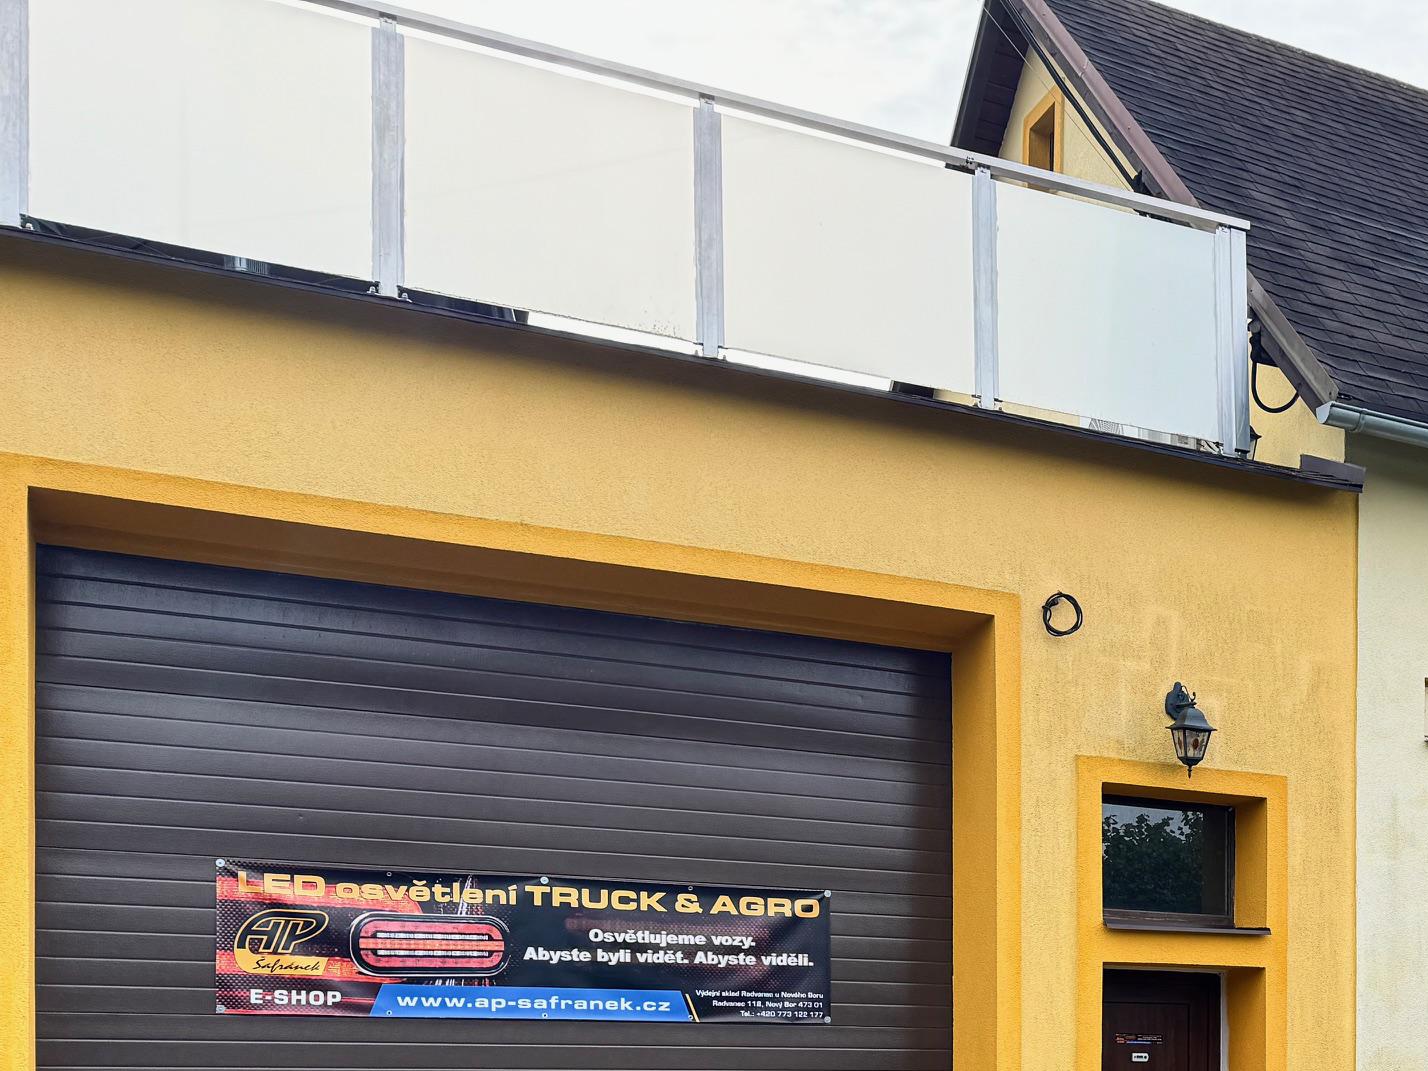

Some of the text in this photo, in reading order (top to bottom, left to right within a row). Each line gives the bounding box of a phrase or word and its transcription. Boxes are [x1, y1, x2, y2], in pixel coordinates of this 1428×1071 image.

[238, 870, 820, 918] LED osvětlení TRUCK & AGRO
[588, 928, 756, 949] Osvětlujeme vozy.
[252, 956, 321, 973] Šafránek
[523, 946, 814, 967] Abyste byli vidět. Abyste viděli.
[250, 988, 342, 1006] E-SHOP
[396, 995, 671, 1012] www.ap-safranek.cz
[766, 1000, 782, 1009] Nový
